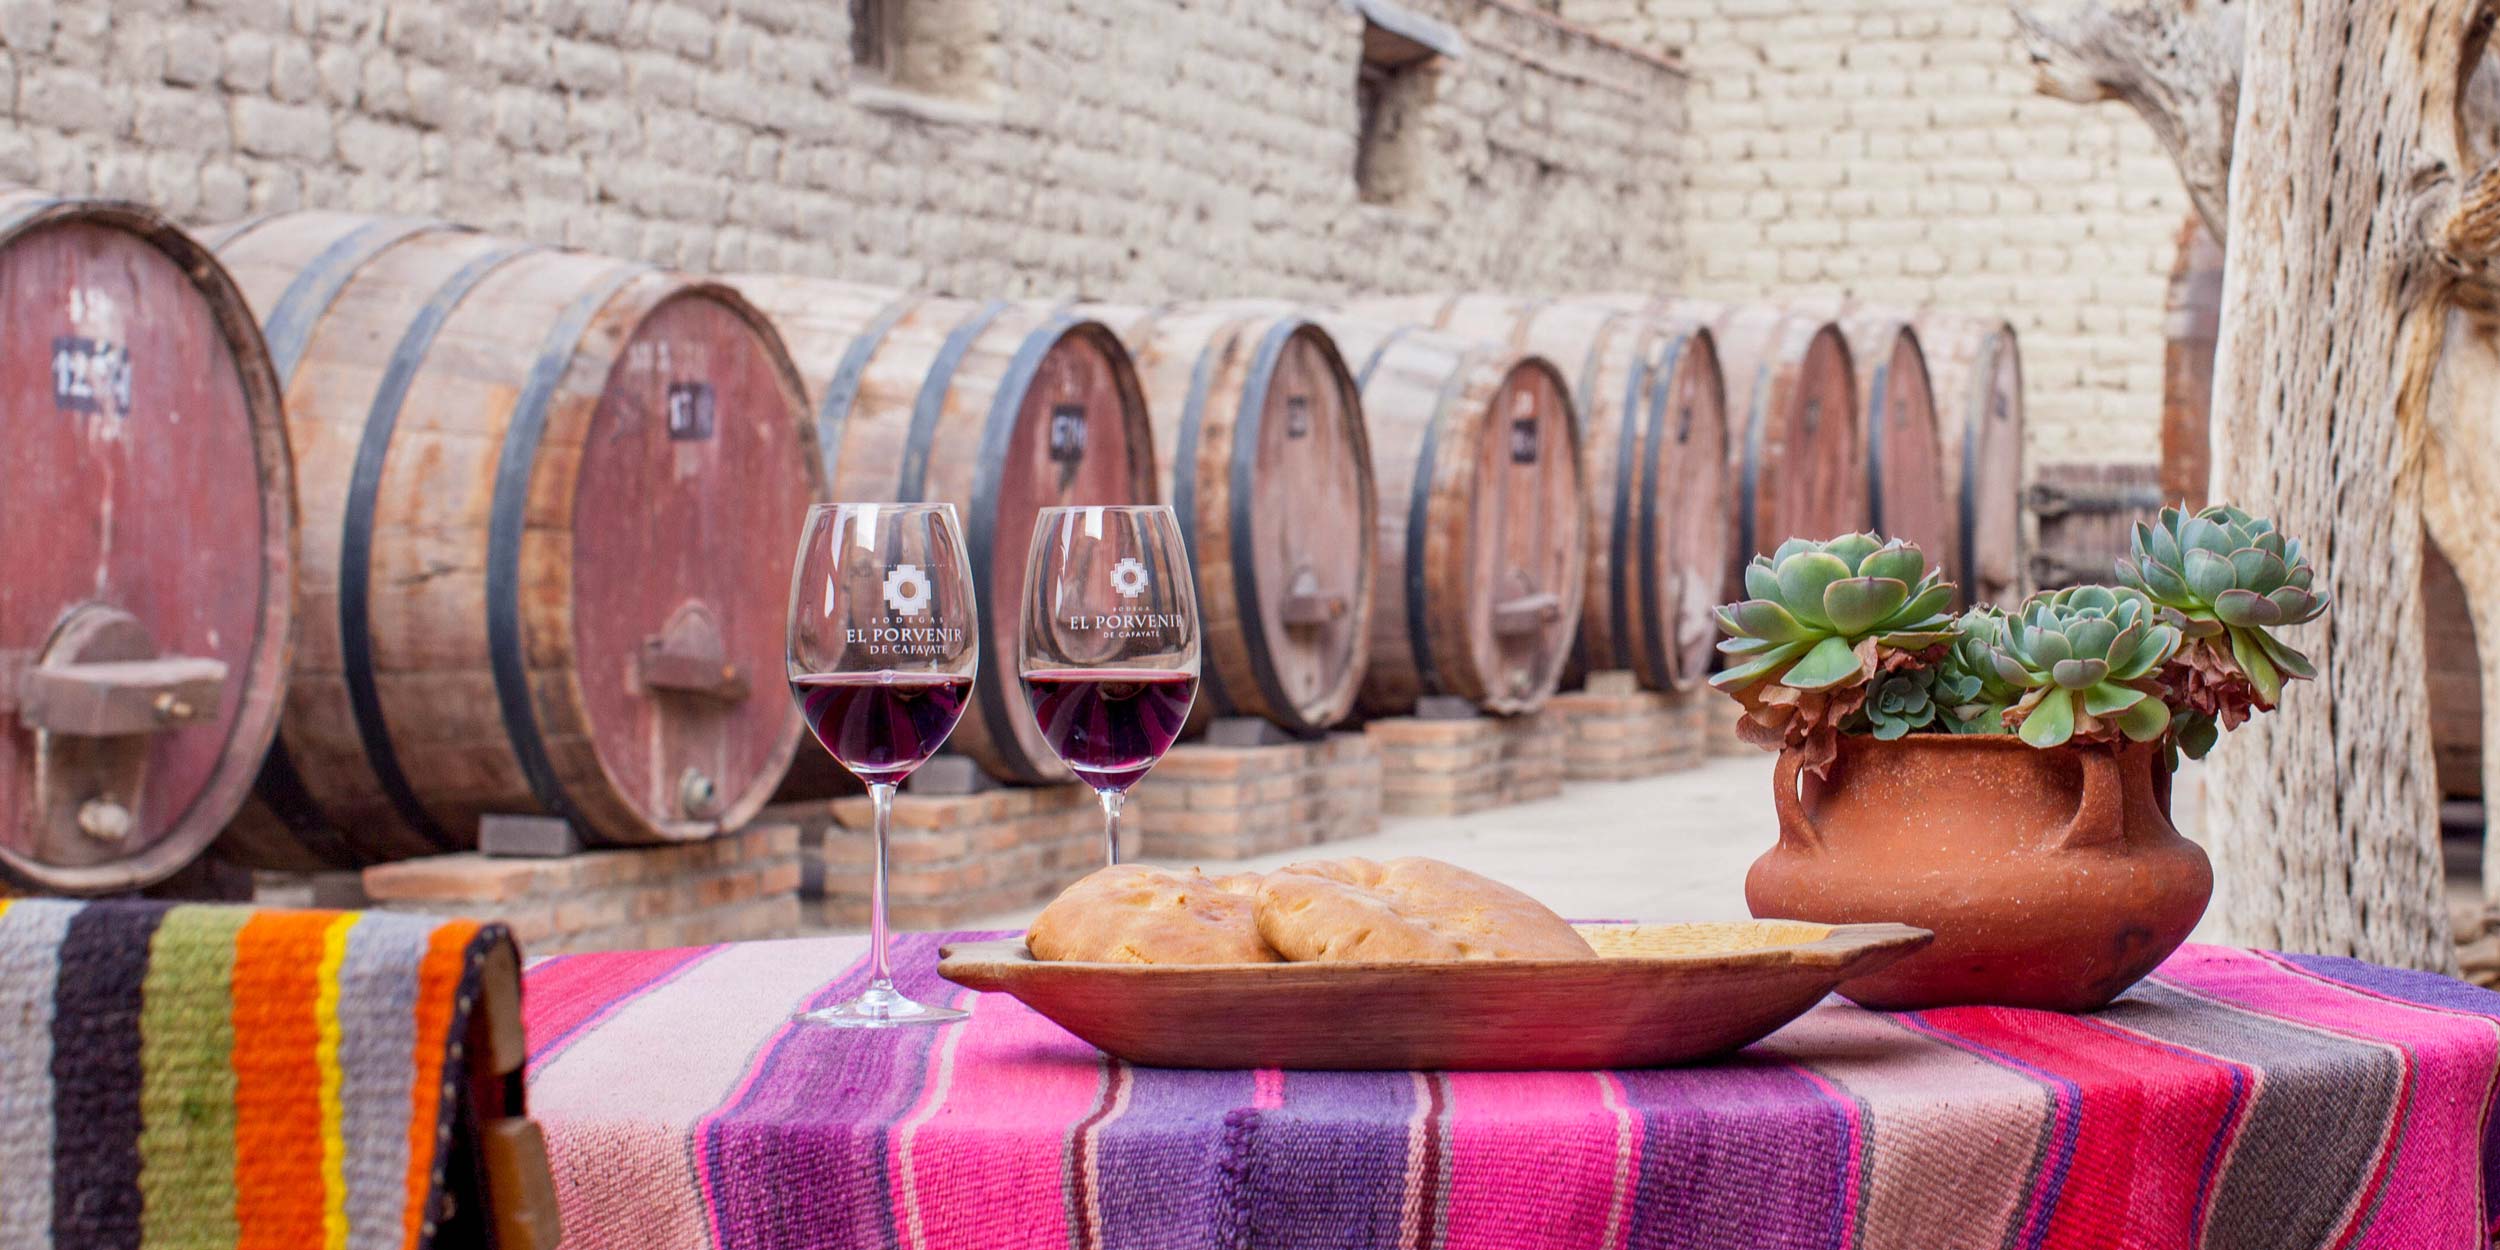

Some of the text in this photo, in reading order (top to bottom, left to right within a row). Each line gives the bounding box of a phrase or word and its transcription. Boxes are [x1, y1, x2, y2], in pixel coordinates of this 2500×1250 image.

[872, 616, 944, 625] BODEGAS
[1070, 614, 1183, 630] EL PORVENIR
[846, 627, 962, 643] EL PORVENIR
[1103, 630, 1160, 639] DE CAFAYATE
[870, 644, 946, 656] DE CAFAYATE
